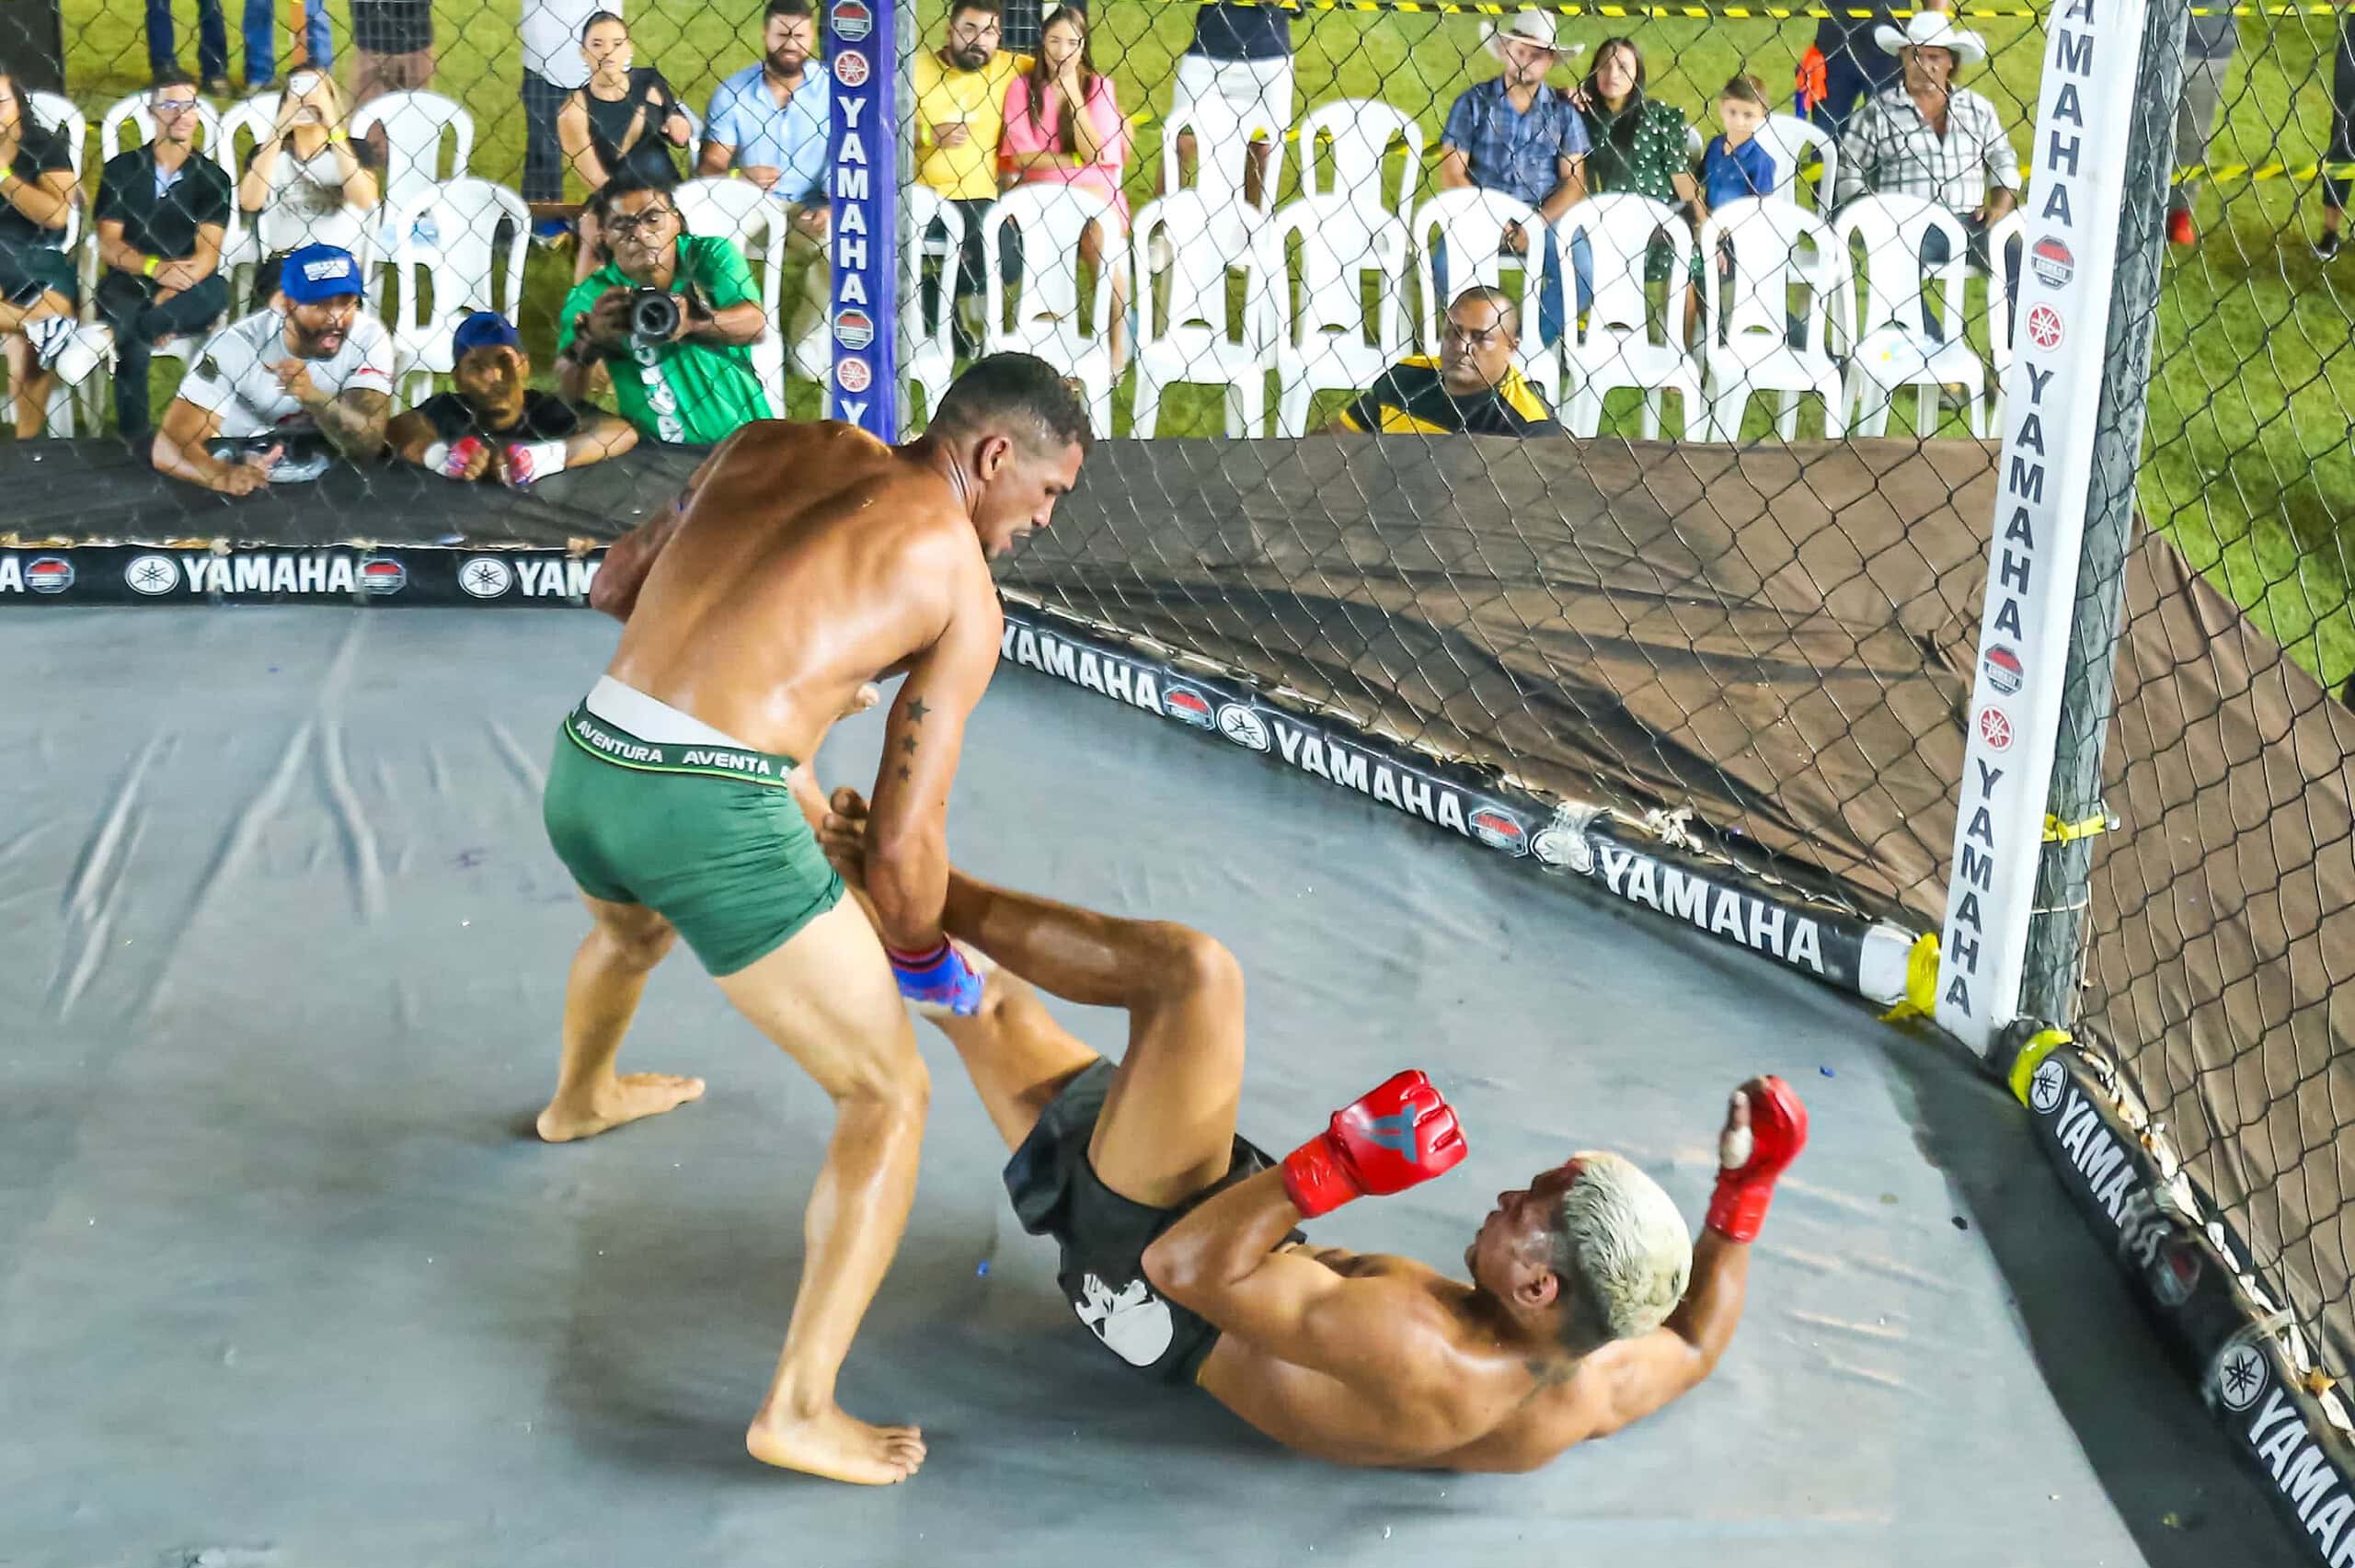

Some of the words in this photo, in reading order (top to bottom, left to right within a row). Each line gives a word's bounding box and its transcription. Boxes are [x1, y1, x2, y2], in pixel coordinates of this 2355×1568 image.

[837, 97, 868, 304] YAMAHA
[1994, 361, 2053, 641] YAMAHA
[181, 556, 356, 592] YAMAHA
[576, 721, 662, 762] AVENTURA
[683, 750, 770, 775] AVENTA
[1273, 721, 1469, 837] YAMAHA
[1601, 845, 1824, 975] YAMAHA
[1946, 757, 2004, 1017] YAMAHA
